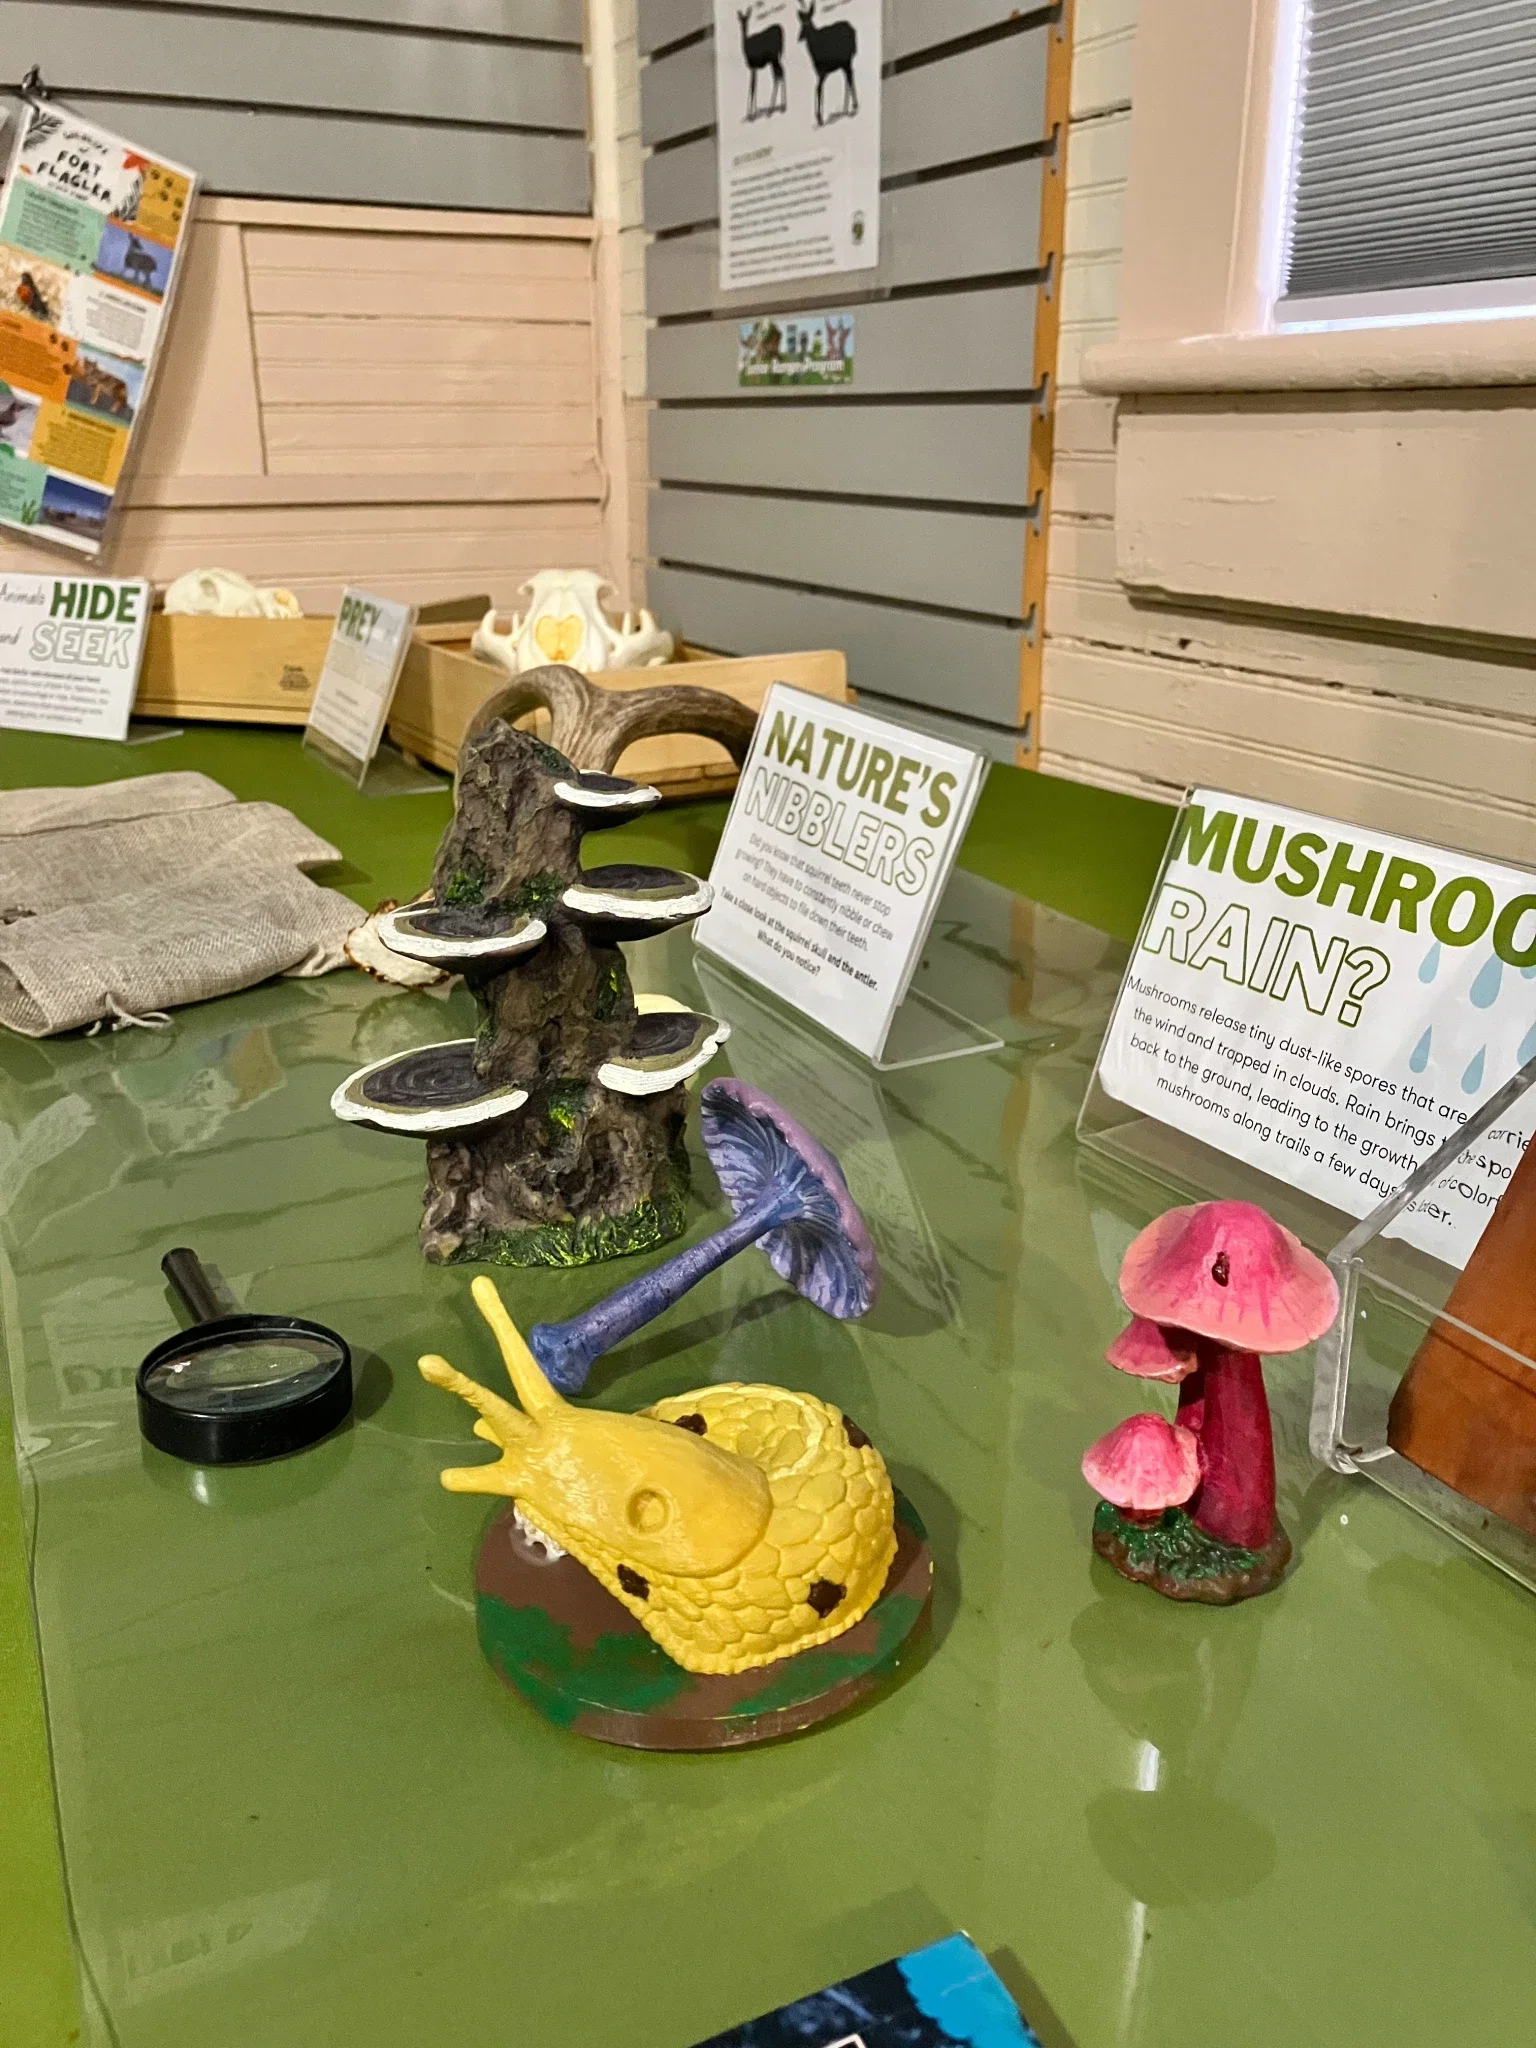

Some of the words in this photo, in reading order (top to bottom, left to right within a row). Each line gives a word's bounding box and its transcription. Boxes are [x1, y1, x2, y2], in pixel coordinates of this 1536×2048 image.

[57, 150, 101, 177] FORT
[29, 620, 134, 670] SEEK
[50, 582, 141, 623] HIDE
[338, 595, 382, 645] PREY
[764, 710, 958, 829] NATURE'S
[744, 767, 935, 896] NIBBLERS
[760, 842, 773, 854] you
[773, 846, 791, 862] know
[789, 855, 805, 871] that
[804, 864, 832, 885] squirrel
[831, 877, 851, 894] teeth
[851, 888, 873, 906] never
[872, 899, 891, 918] stop
[721, 886, 734, 903] Take
[738, 899, 754, 915] close
[753, 907, 767, 922] look
[767, 916, 776, 928] at
[775, 920, 786, 935] the
[785, 927, 812, 949] squirrel
[811, 943, 828, 960] skull
[827, 953, 843, 969] and
[842, 961, 855, 976] the
[854, 970, 879, 992] antler.
[735, 848, 764, 871] growing?
[764, 861, 778, 880] They
[778, 870, 794, 887] have
[794, 880, 803, 892] to
[803, 885, 837, 914] constantly
[838, 905, 863, 925] nibble
[862, 918, 872, 929] or
[871, 923, 894, 941] chew
[743, 872, 752, 883] on
[751, 876, 767, 892] hard
[766, 886, 790, 906] objects
[789, 899, 798, 911] to
[798, 901, 810, 917] file
[809, 911, 829, 929] down
[829, 921, 847, 938] their
[847, 931, 868, 951] teeth.
[757, 928, 773, 948] What
[773, 941, 782, 954] do
[781, 947, 796, 962] you
[795, 955, 821, 977] notice?
[1141, 882, 1391, 1028] RAIN?
[1127, 974, 1198, 1015] Mushrooms
[1199, 1008, 1248, 1034] release
[1249, 1024, 1276, 1051] tiny
[1279, 1036, 1343, 1073] dust-like
[1344, 1064, 1398, 1096] spores
[1401, 1086, 1436, 1112] that
[1437, 1104, 1468, 1125] are
[1133, 1006, 1154, 1026] the
[1155, 1018, 1187, 1039] wind
[1186, 1030, 1216, 1051] and
[1216, 1041, 1272, 1075] trapped
[1273, 1063, 1288, 1082] in
[1289, 1073, 1340, 1106] clouds.
[1345, 1093, 1381, 1123] Rain
[1384, 1110, 1437, 1147] brings
[1130, 1032, 1161, 1058] back
[1163, 1049, 1177, 1065] to
[1178, 1055, 1199, 1075] the
[1201, 1067, 1253, 1101] ground,
[1256, 1087, 1312, 1127] leading
[1314, 1114, 1330, 1133] to
[1334, 1122, 1358, 1146] the
[1360, 1138, 1419, 1173] growth
[1156, 1076, 1231, 1119] mushrooms
[1233, 1110, 1273, 1142] along
[1275, 1129, 1311, 1158] trails
[1314, 1150, 1325, 1163] a
[1329, 1153, 1357, 1178] few
